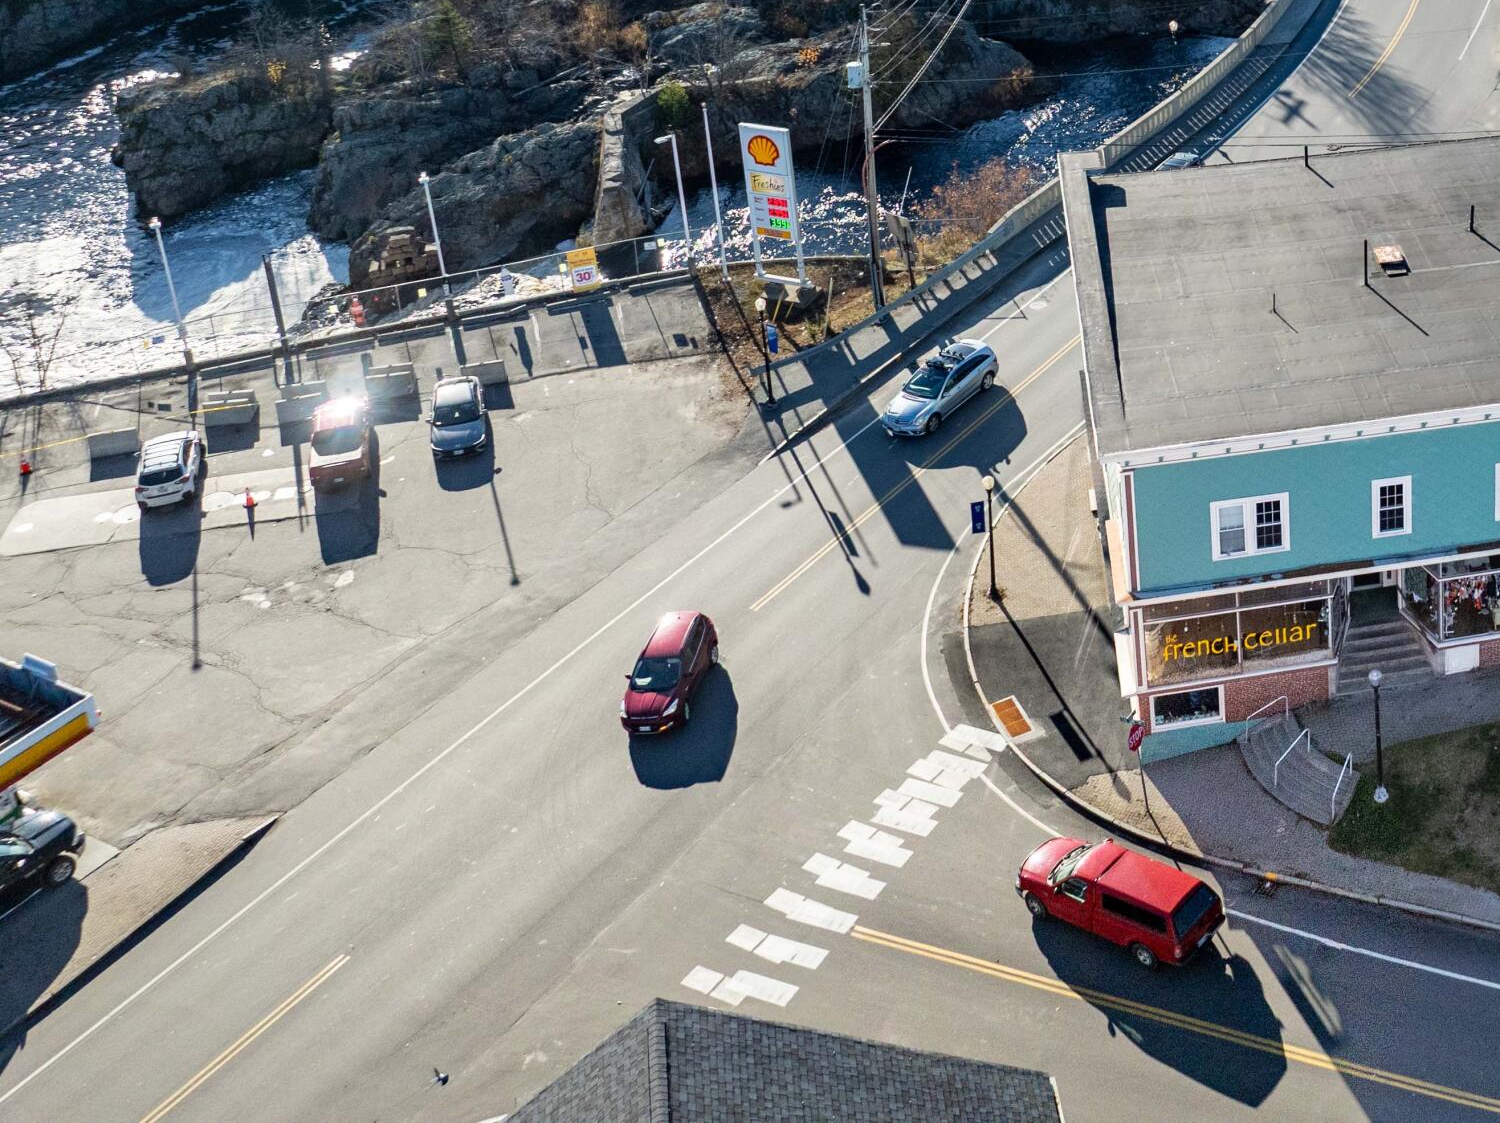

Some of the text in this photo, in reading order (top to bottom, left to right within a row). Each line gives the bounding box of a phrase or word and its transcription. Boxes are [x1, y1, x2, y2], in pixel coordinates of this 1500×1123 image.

[751, 175, 785, 193] Freshies
[1163, 623, 1318, 662] french cellar
[1165, 634, 1178, 644] the
[1128, 726, 1143, 748] STOP
